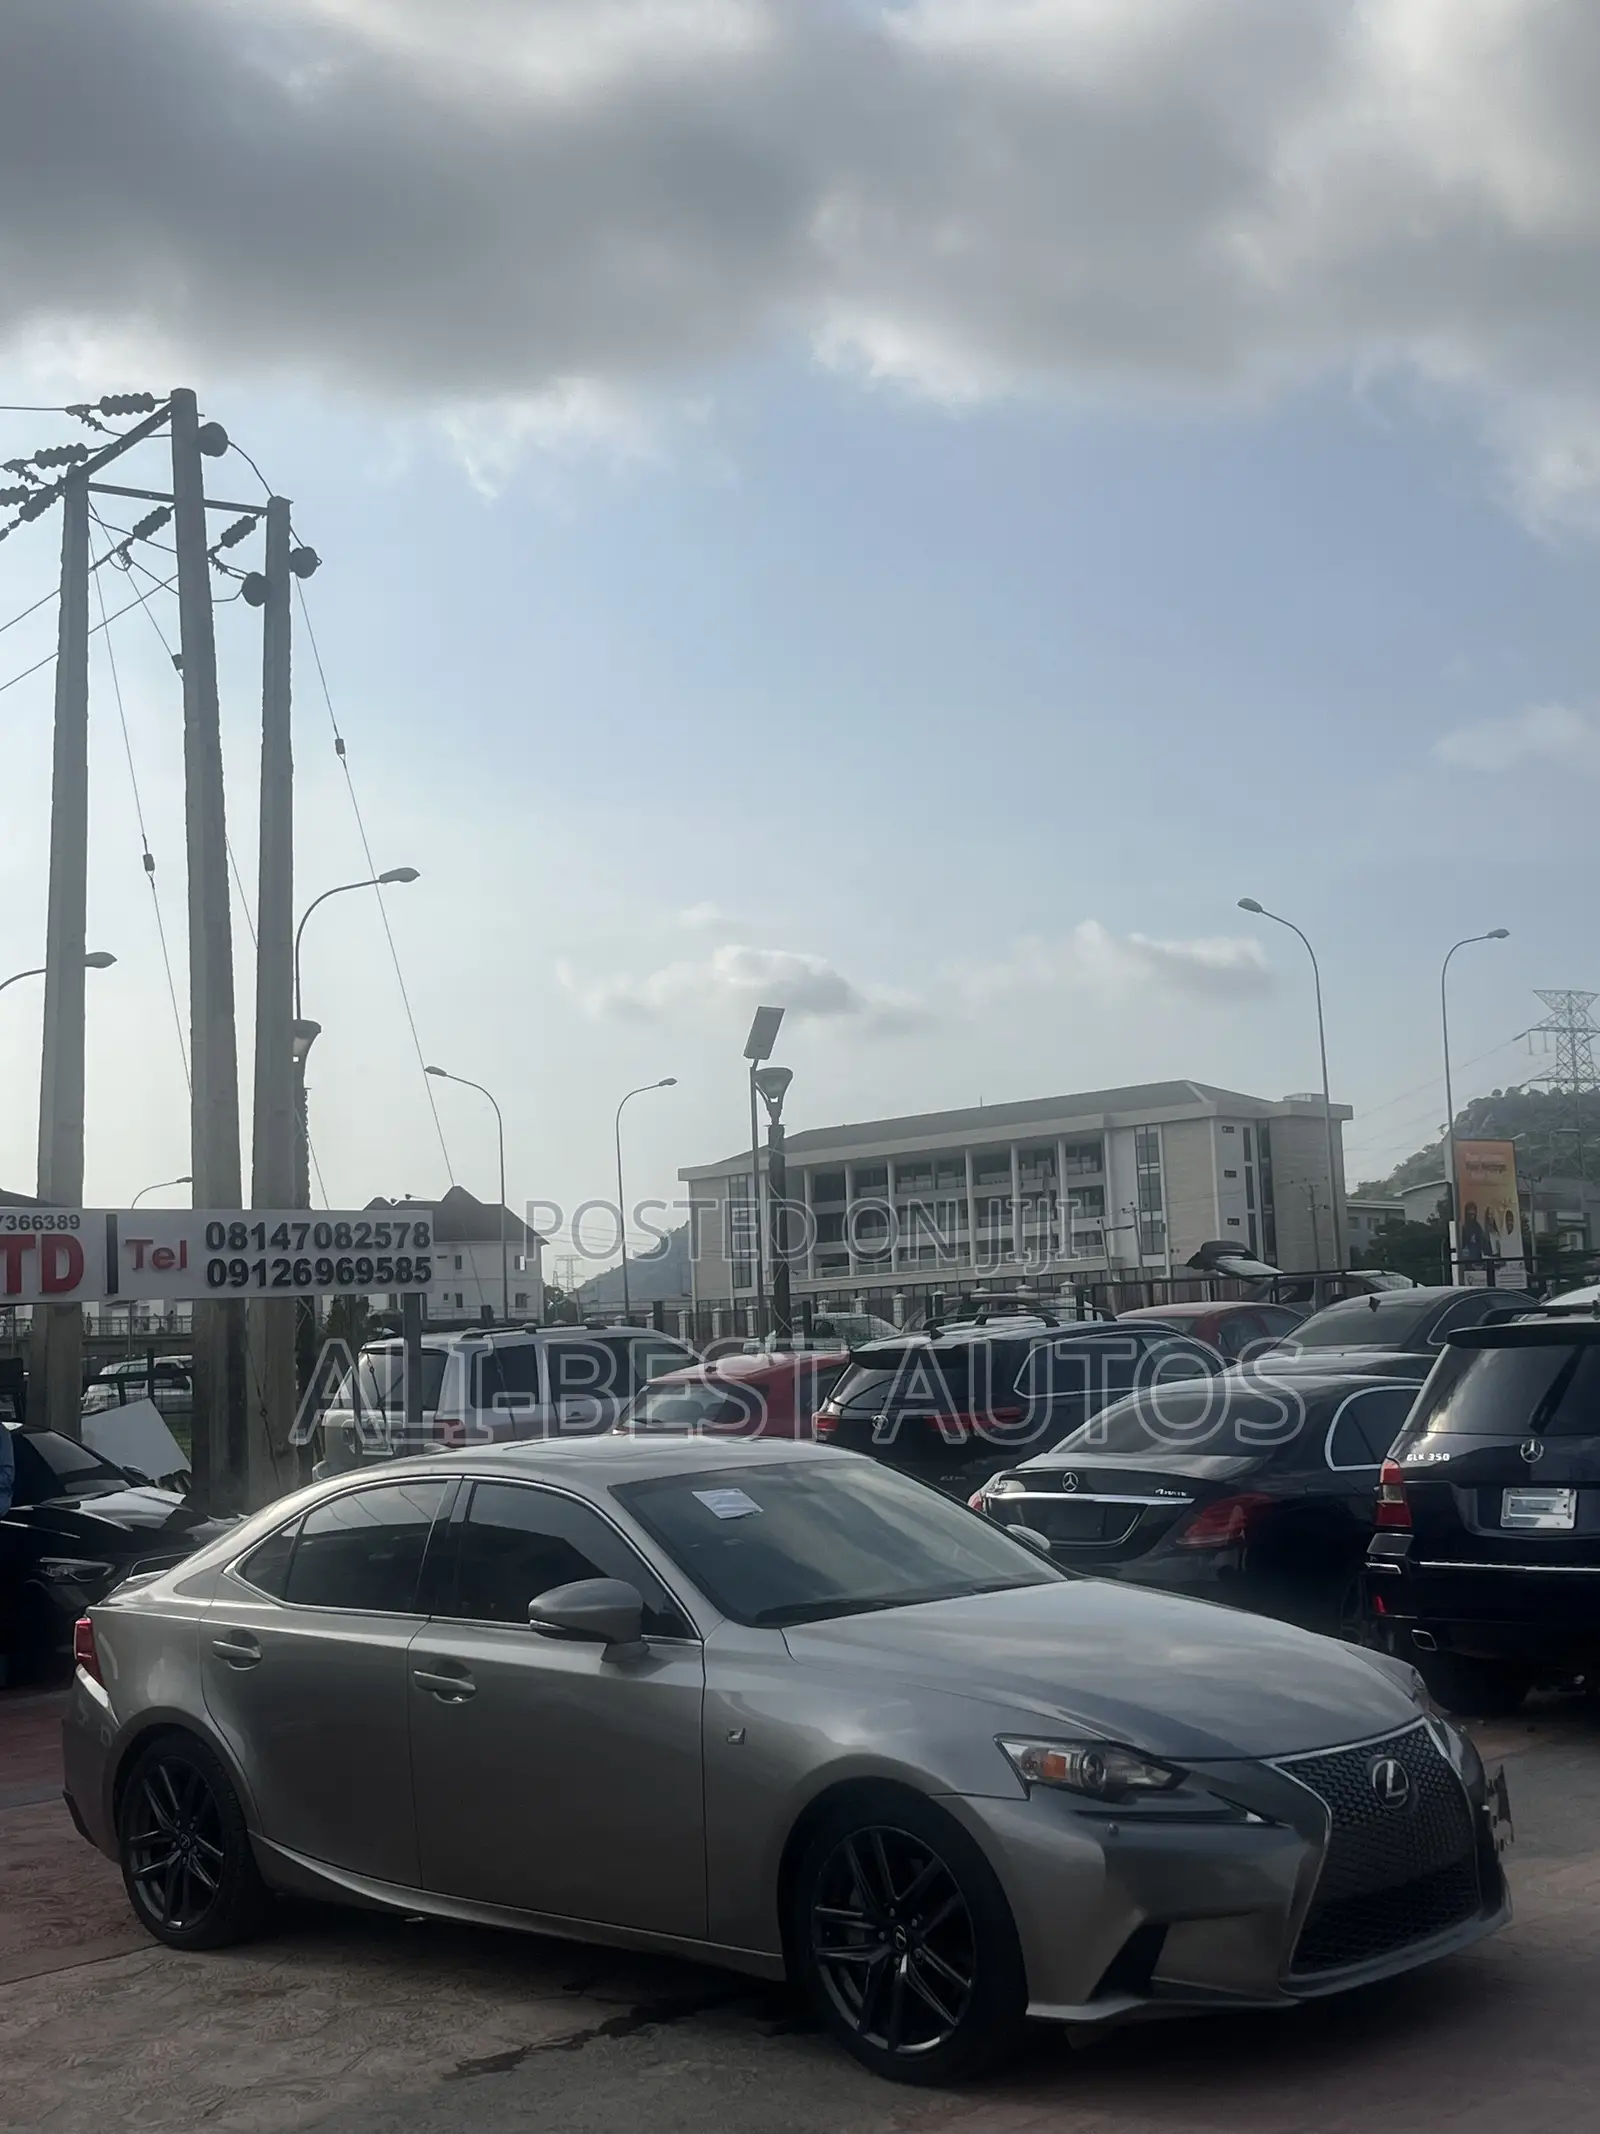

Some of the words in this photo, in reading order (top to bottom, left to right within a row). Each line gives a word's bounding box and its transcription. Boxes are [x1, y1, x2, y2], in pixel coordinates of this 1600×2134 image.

[205, 1221, 431, 1250] 08147082578
[125, 1238, 188, 1270] Tel
[206, 1256, 432, 1288] 09126969585
[1427, 1453, 1451, 1462] 350
